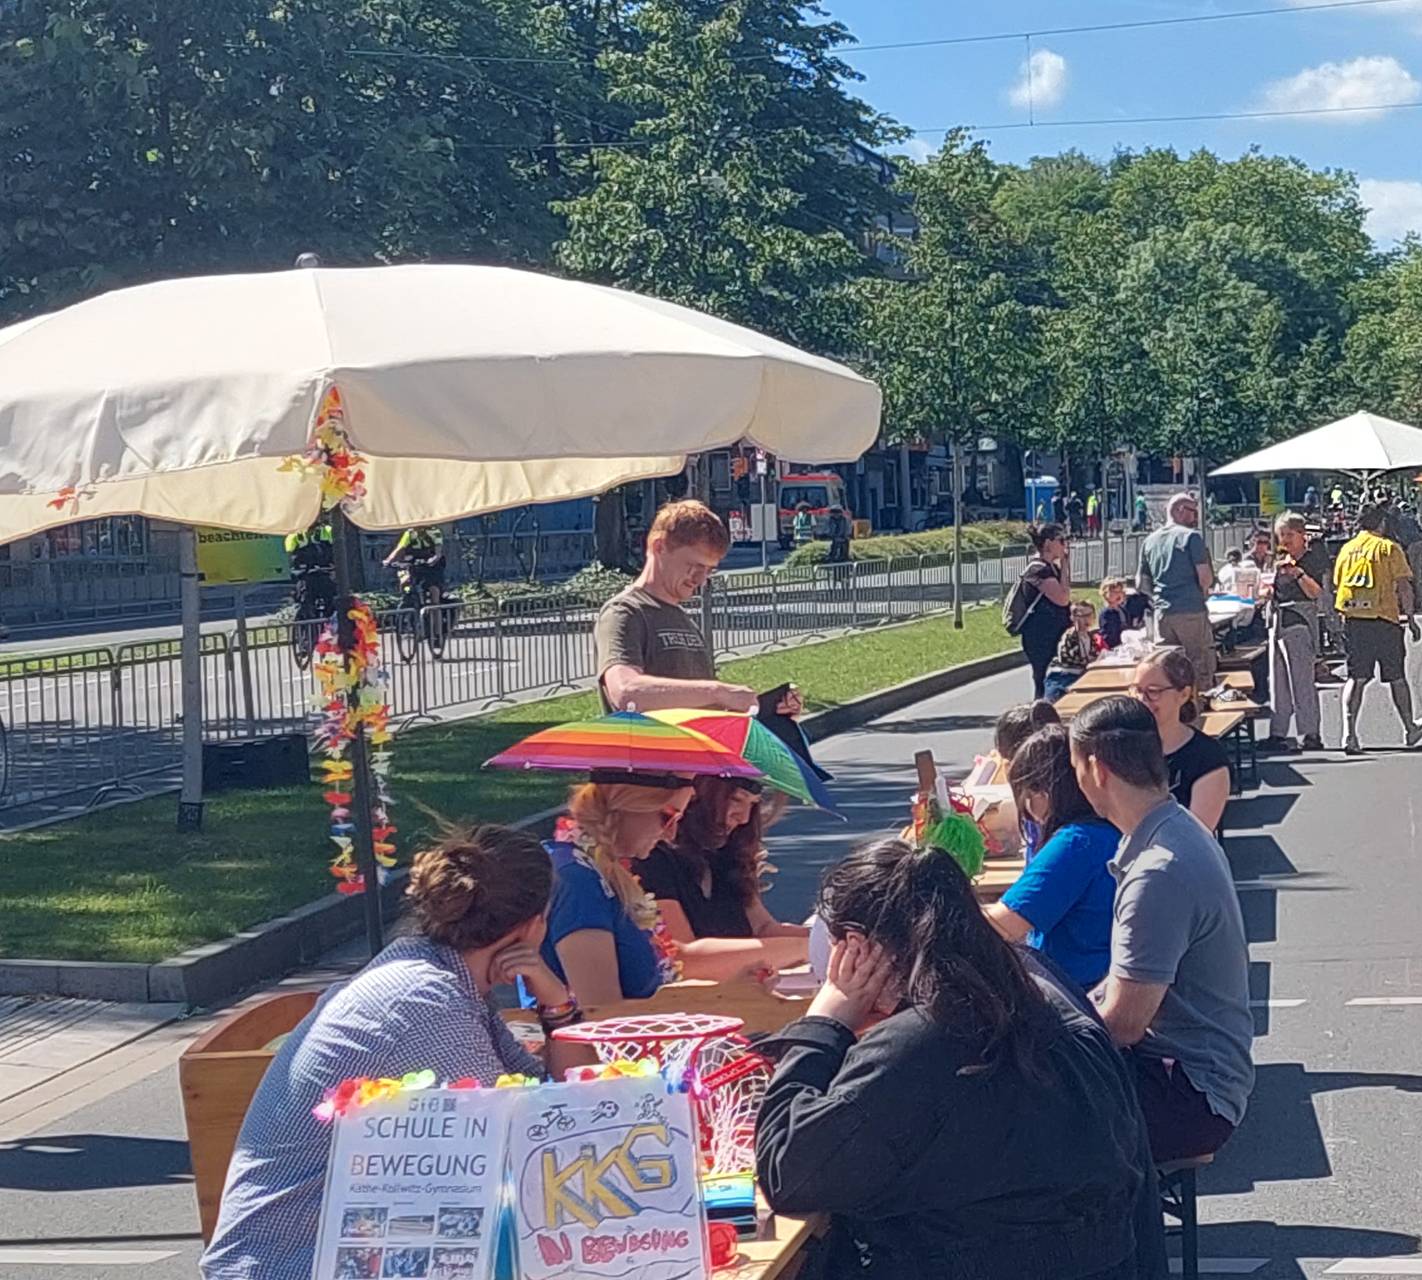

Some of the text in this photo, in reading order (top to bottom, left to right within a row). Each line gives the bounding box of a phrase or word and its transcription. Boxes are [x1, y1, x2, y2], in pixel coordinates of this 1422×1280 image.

[363, 1116, 488, 1139] SCHULE IN
[351, 1154, 487, 1177] BEWEGUNG
[541, 1123, 678, 1231] KKG
[537, 1231, 573, 1267] IN
